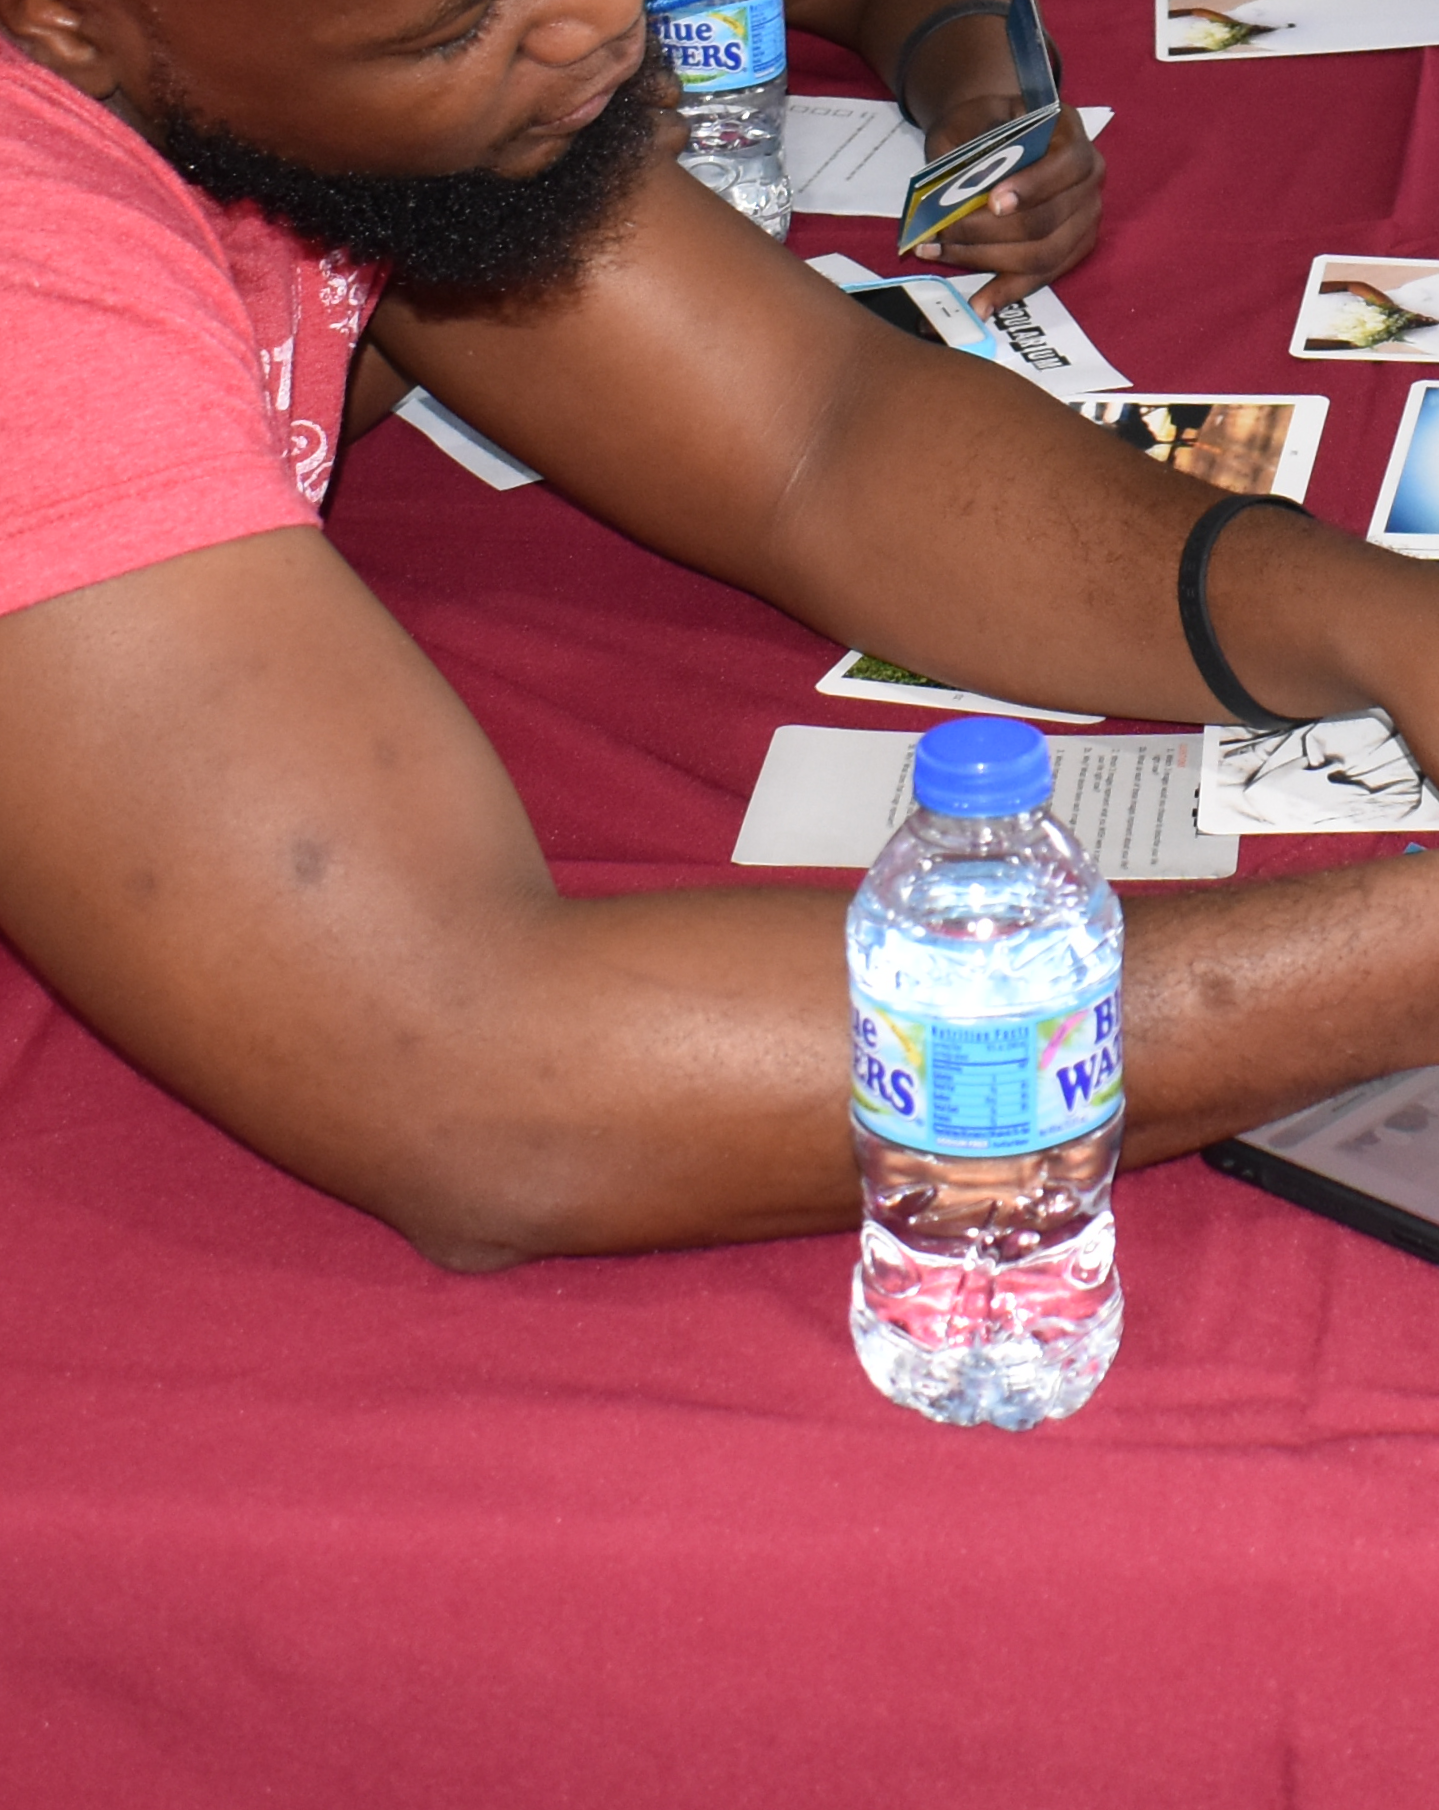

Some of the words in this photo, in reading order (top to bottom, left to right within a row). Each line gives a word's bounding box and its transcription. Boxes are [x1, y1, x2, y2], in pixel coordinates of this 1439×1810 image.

[662, 42, 742, 71] TERS
[992, 298, 1071, 370] SOULARIUM
[932, 1026, 990, 1040] Nutrition
[996, 1027, 1029, 1039] Facts
